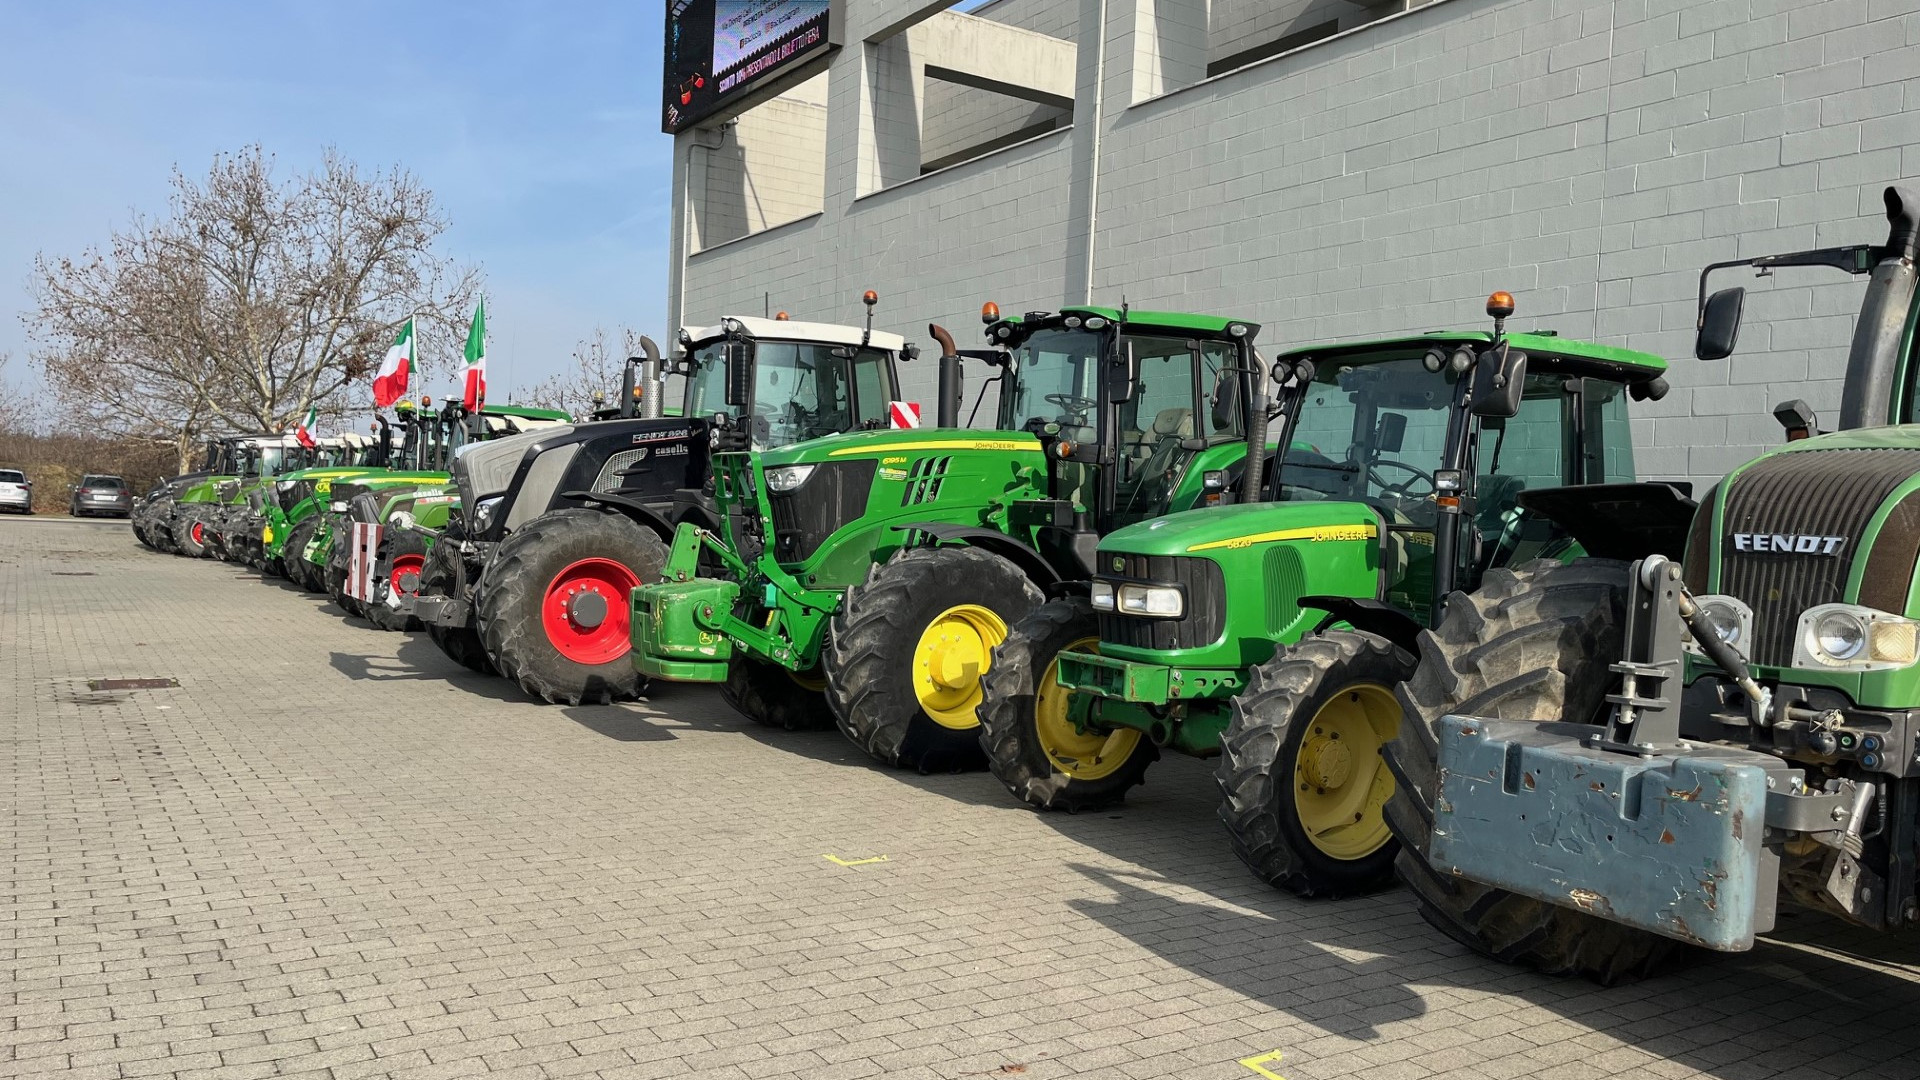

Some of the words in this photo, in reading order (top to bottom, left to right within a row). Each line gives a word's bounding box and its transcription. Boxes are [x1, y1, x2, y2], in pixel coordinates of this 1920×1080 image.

[632, 430, 668, 444] FENDT
[1311, 531, 1338, 542] JOHN
[1337, 530, 1368, 541] DEERE
[1734, 533, 1845, 555] FENDT
